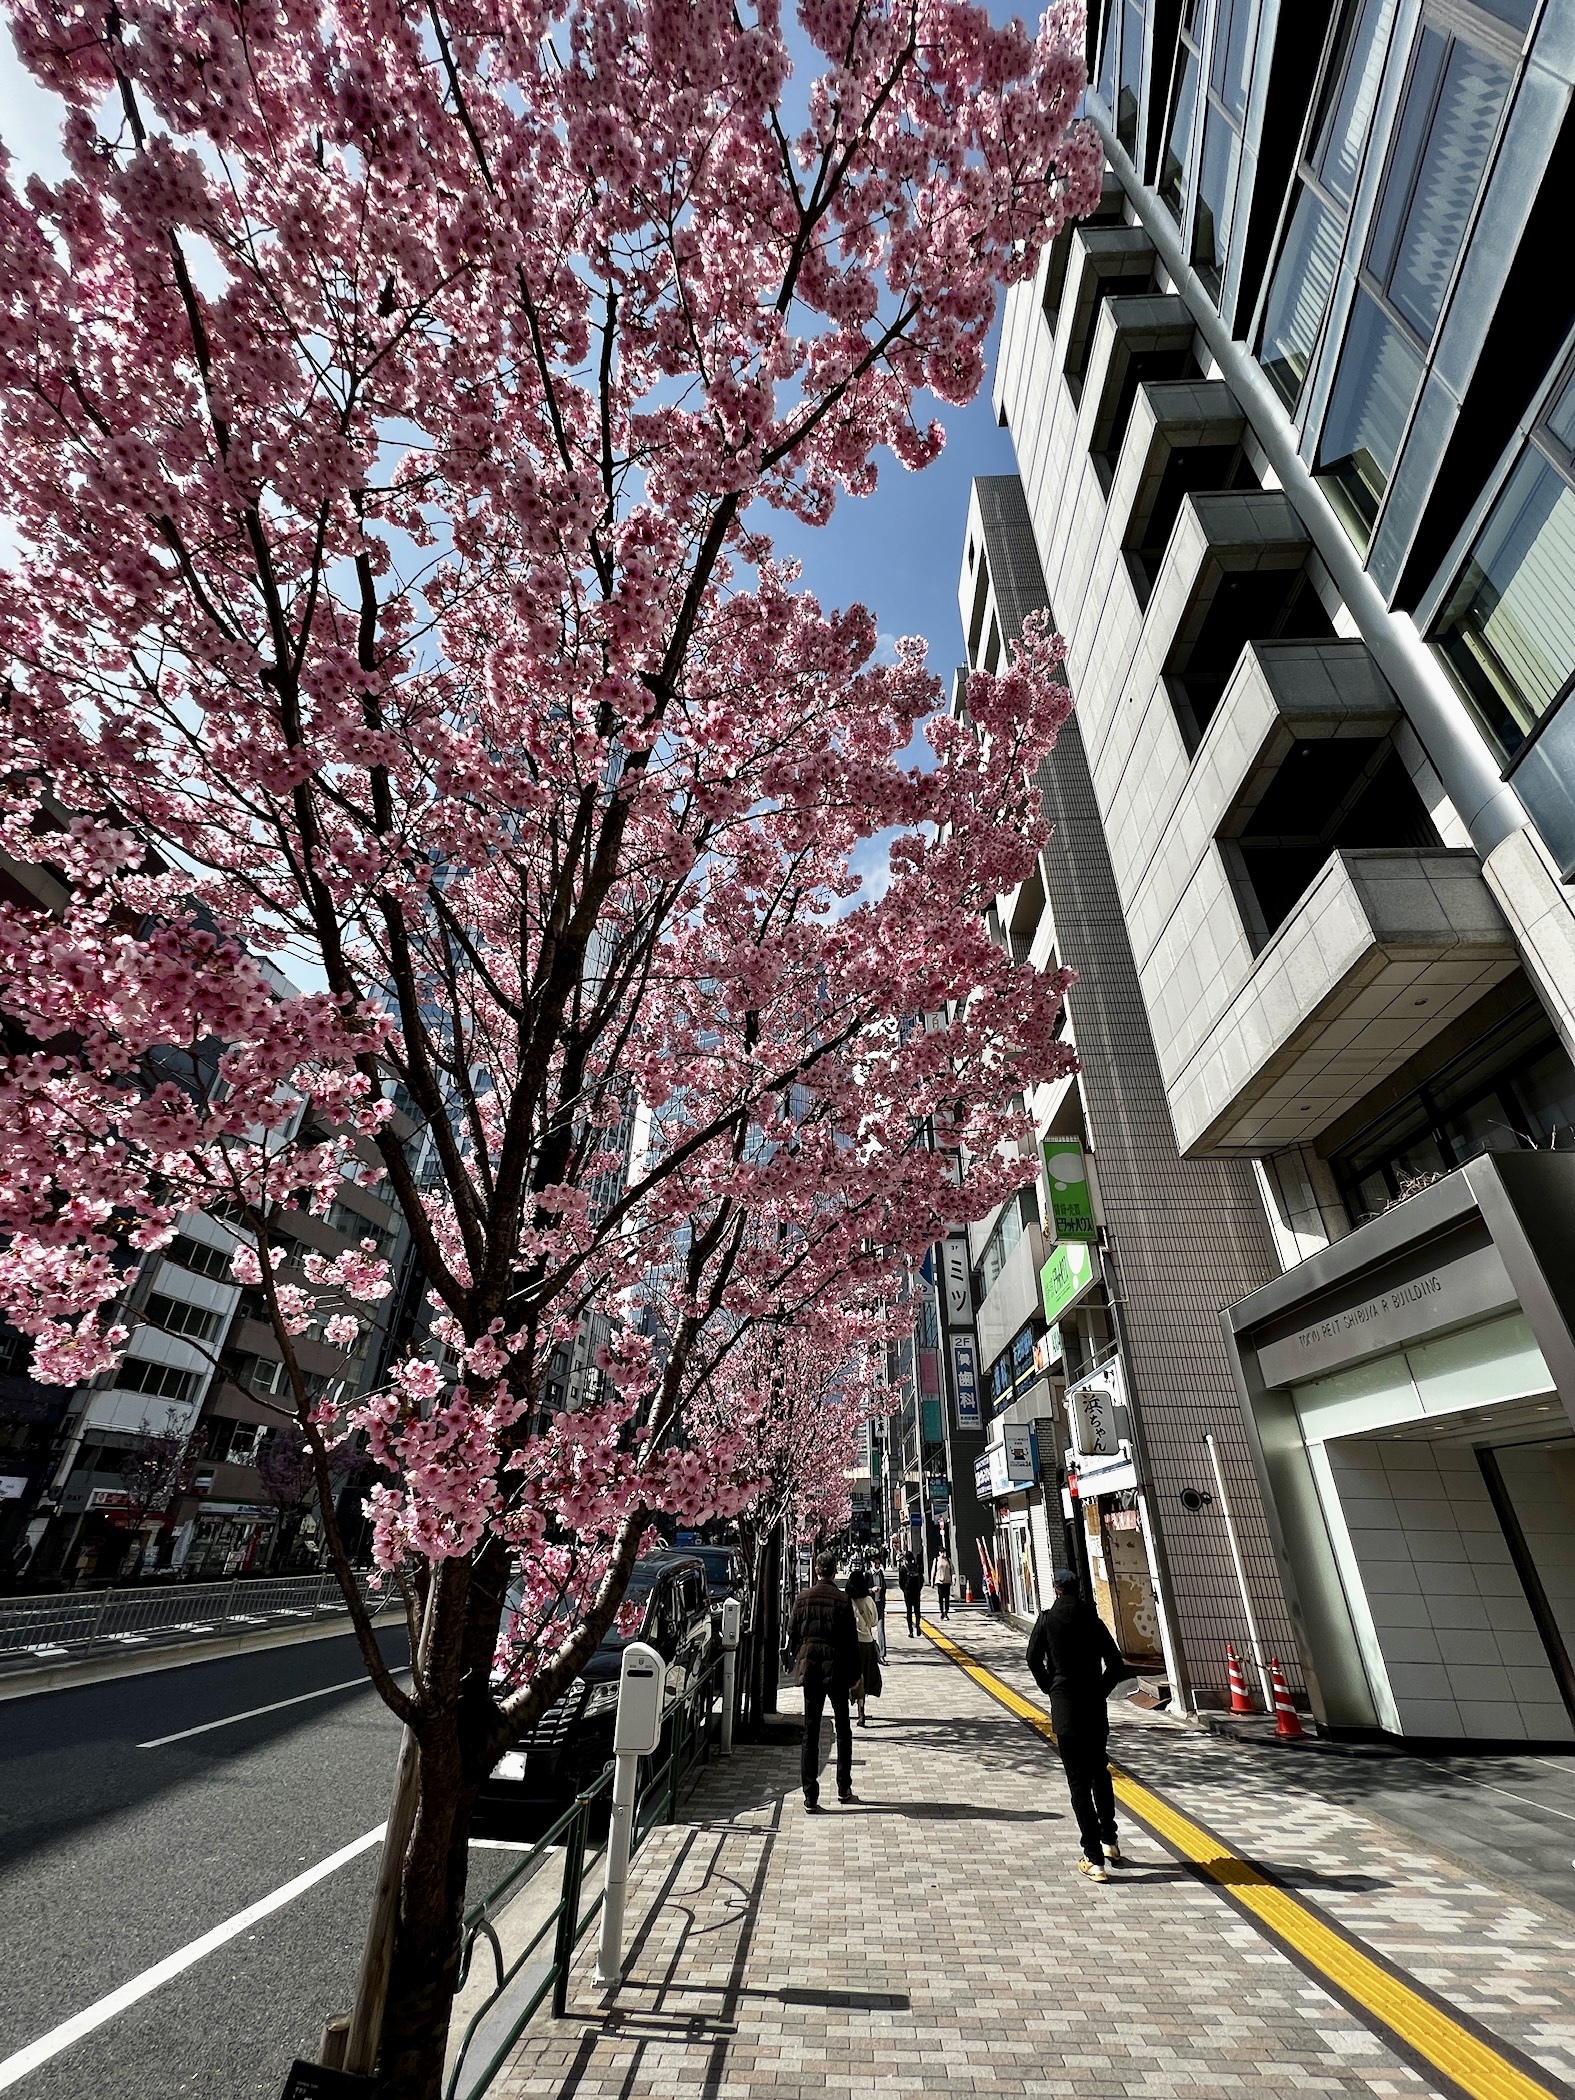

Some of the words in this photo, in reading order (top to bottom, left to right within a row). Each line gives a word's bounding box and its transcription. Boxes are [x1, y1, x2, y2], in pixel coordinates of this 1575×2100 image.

[1056, 1217, 1094, 1232] ピタットハウス
[1298, 1332, 1321, 1349] TOKYU
[1322, 1319, 1341, 1339] REIT
[1343, 1307, 1379, 1330] SHIBUYA
[1381, 1299, 1390, 1312] R
[1391, 1276, 1442, 1309] BUILDING
[954, 1337, 970, 1347] 2F
[957, 1371, 976, 1409] 歯科
[1082, 1394, 1107, 1452] 浜ちゃん
[65, 1494, 82, 1502] RAY
